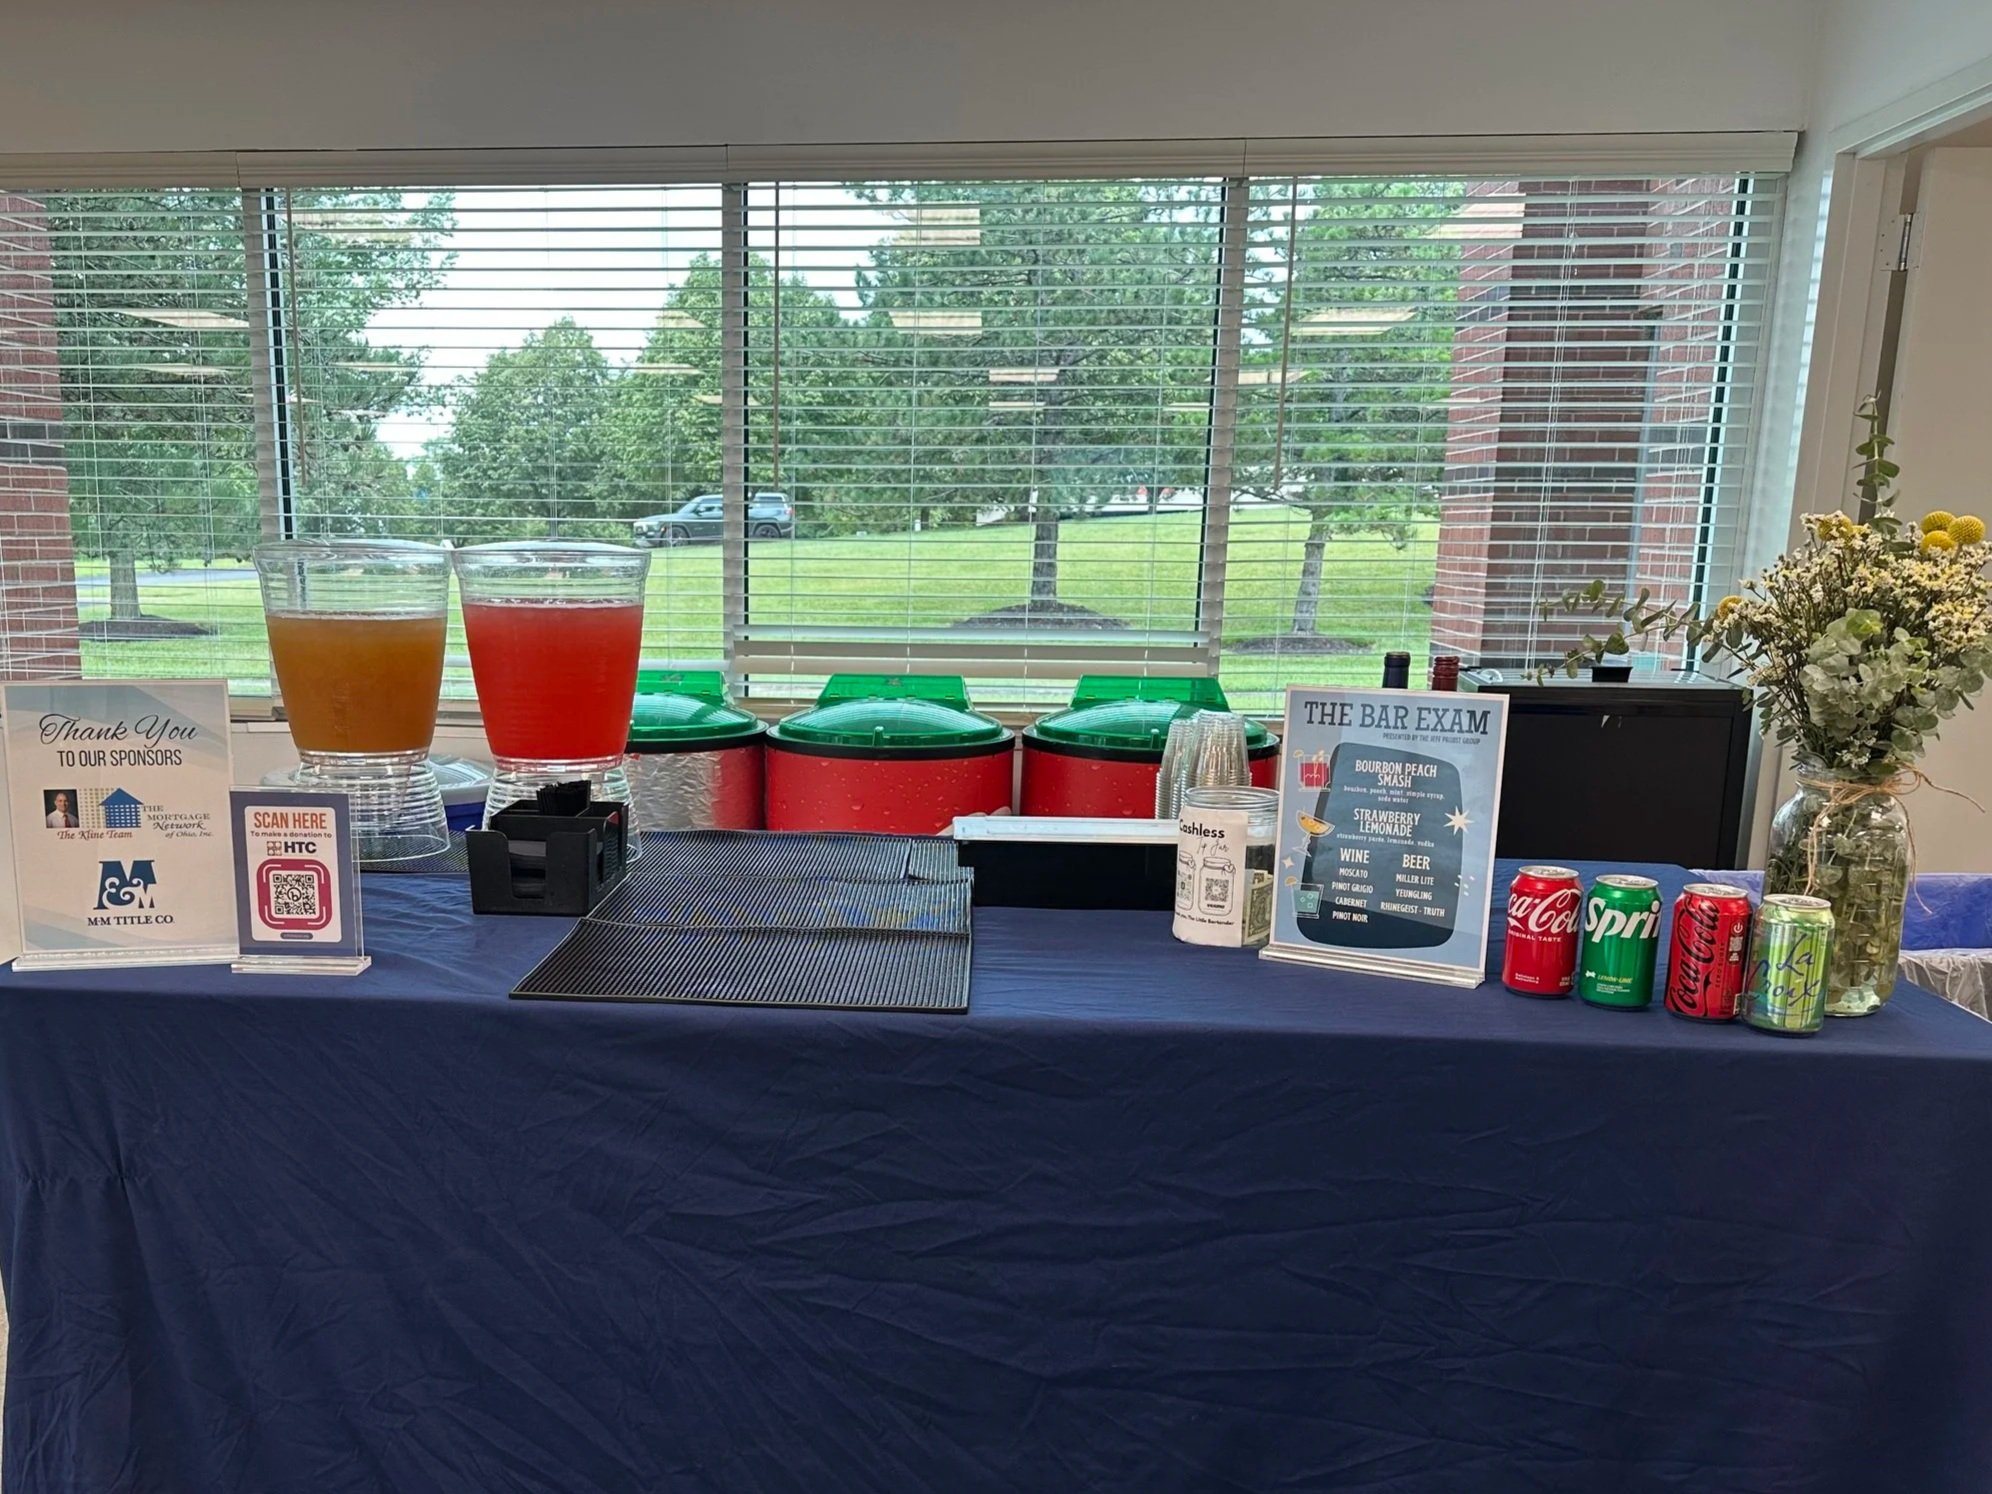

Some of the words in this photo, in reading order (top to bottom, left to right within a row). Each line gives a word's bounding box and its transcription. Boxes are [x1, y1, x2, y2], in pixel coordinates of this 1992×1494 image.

[1305, 701, 1354, 727] THE
[1359, 703, 1409, 731] BAR
[1415, 707, 1491, 735] EXAM
[39, 713, 129, 745] Thank
[134, 714, 199, 749] You
[1382, 732, 1412, 741] PRESENTED
[57, 750, 75, 767] TO
[79, 750, 107, 767] OUR
[110, 749, 182, 767] SPONSORS
[1355, 760, 1403, 775] BOURBON
[1404, 763, 1438, 778] PEACH
[1377, 774, 1412, 788] SMASH
[147, 813, 211, 821] MORTGAGE
[253, 812, 289, 829] SCAN
[292, 812, 328, 829] HERE
[1353, 808, 1421, 826] STRAWBERRY
[153, 820, 206, 831] Network
[1179, 819, 1226, 839] Cashless
[1359, 820, 1413, 837] LEMONADE
[57, 830, 75, 839] The
[78, 830, 105, 841] Kline
[106, 830, 133, 839] Team
[1336, 833, 1368, 842] strawberry
[1417, 840, 1435, 848] vodka
[284, 841, 318, 854] HTC
[1340, 847, 1370, 864] WINE
[1402, 854, 1431, 870] BEER
[1339, 867, 1369, 879] MOSCATO
[1396, 873, 1419, 884] MILLER
[1420, 876, 1435, 886] LITE
[1331, 881, 1350, 891] PINOT
[1351, 884, 1374, 894] GRIGIO
[1395, 888, 1433, 900] YEUNGLING
[1335, 896, 1368, 909] CABERNET
[1380, 901, 1419, 914] RHINEGEIST
[1423, 907, 1446, 917] TRUTH
[113, 915, 152, 925] TITLE
[1332, 911, 1351, 921] PINOT
[1352, 913, 1369, 923] NOIR
[1776, 932, 1813, 976] La
